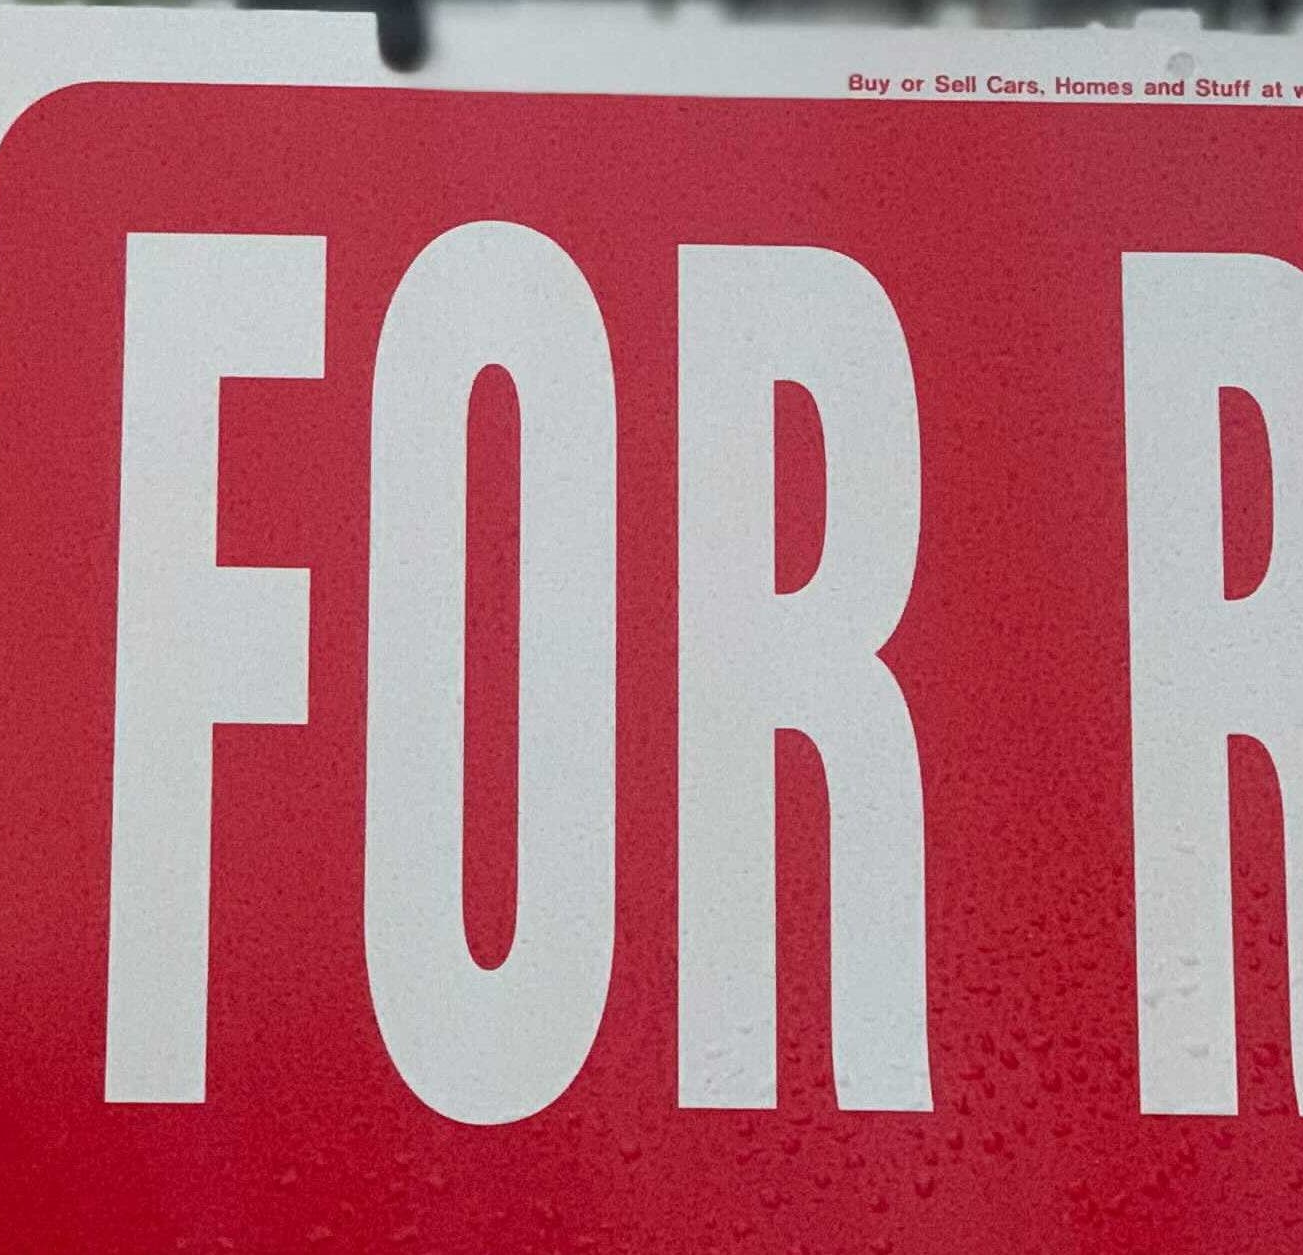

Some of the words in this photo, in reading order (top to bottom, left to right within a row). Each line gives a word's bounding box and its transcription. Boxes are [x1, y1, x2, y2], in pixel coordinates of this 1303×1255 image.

[848, 73, 891, 95] Buy
[900, 78, 925, 93] or
[935, 74, 977, 94] Sell
[987, 75, 1046, 96] Cars,
[1054, 77, 1133, 96] Homes
[1143, 78, 1186, 97] and
[1196, 78, 1252, 98] Stuff
[1261, 82, 1284, 99] at
[104, 220, 934, 1126] FOR
